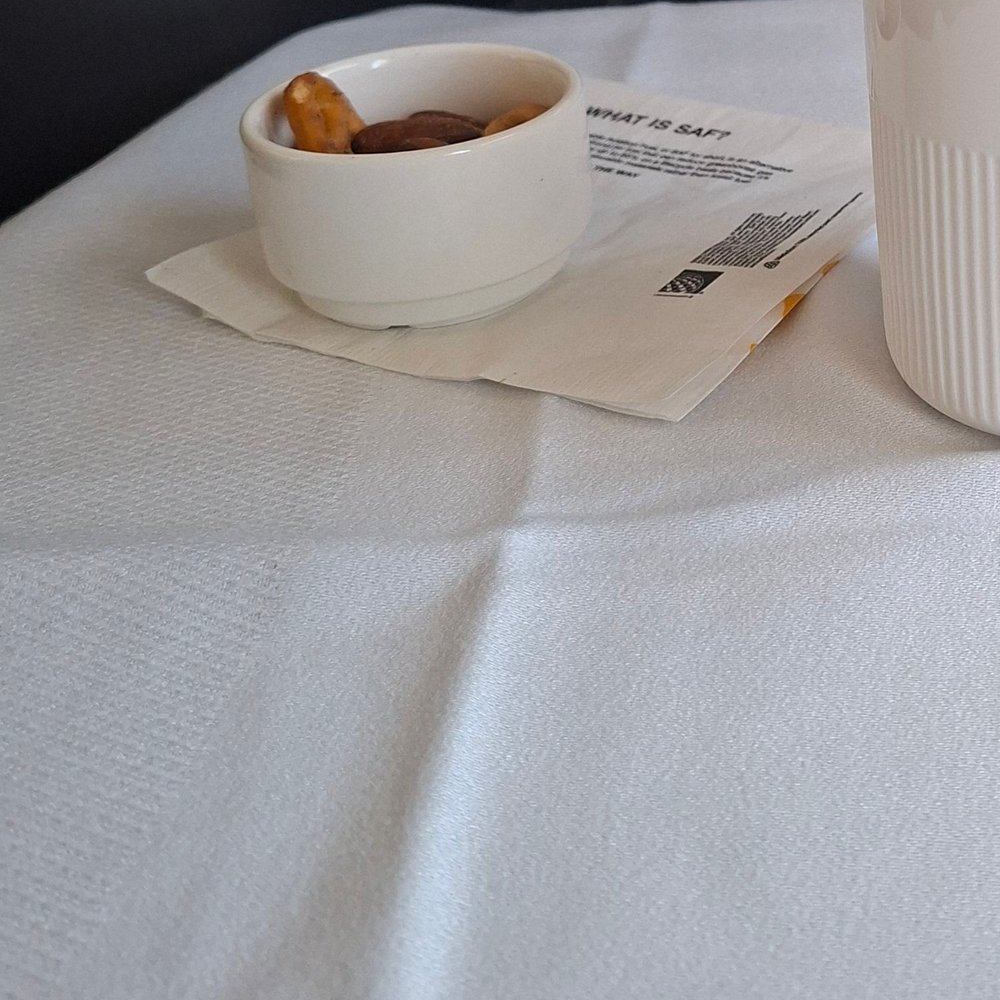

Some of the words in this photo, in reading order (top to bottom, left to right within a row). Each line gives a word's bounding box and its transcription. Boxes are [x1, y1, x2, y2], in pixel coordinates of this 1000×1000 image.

[586, 106, 649, 126] WHAT
[648, 118, 672, 130] IS
[674, 124, 731, 141] SAF?
